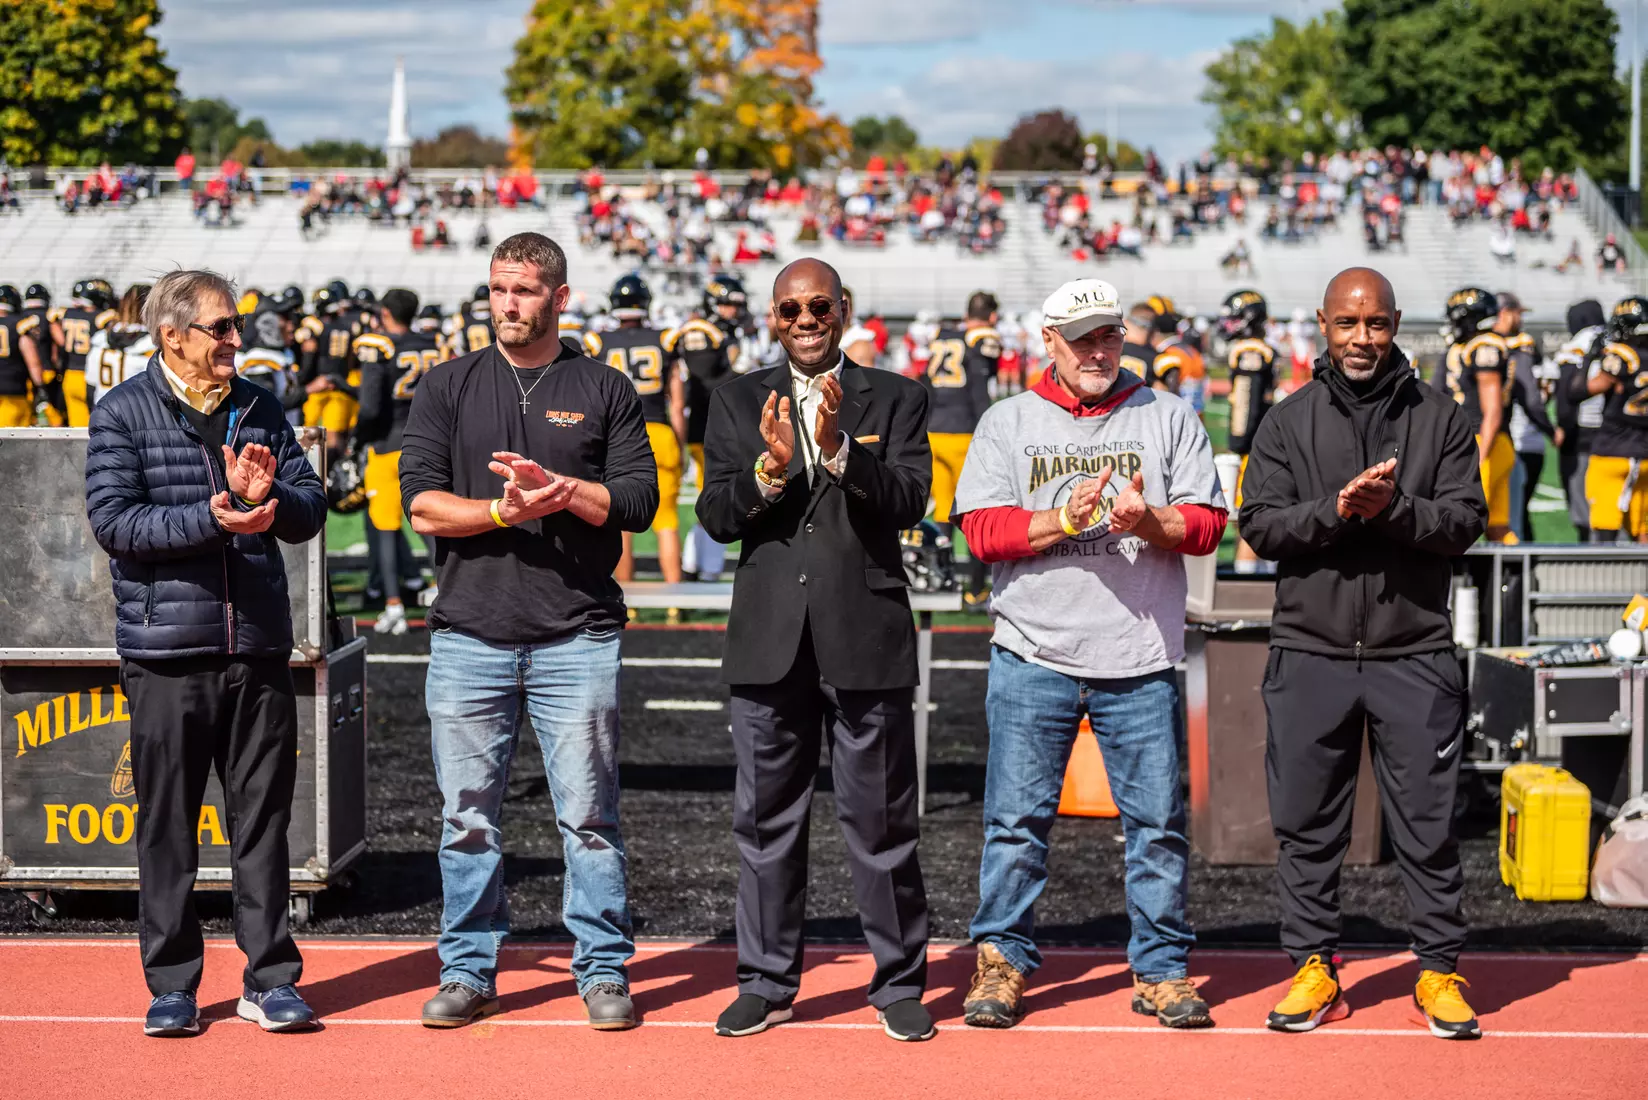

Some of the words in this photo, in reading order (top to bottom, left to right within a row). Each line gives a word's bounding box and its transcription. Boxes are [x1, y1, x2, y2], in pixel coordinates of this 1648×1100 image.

[62, 318, 90, 354] 75
[100, 347, 126, 389] 61
[605, 345, 662, 395] 43
[928, 339, 966, 388] 73
[1024, 445, 1060, 457] GENE
[1065, 440, 1145, 457] CARPENTER'S
[1028, 452, 1141, 494] MARAUDER
[1043, 541, 1100, 557] OTBALL
[1105, 541, 1149, 556] CAMP
